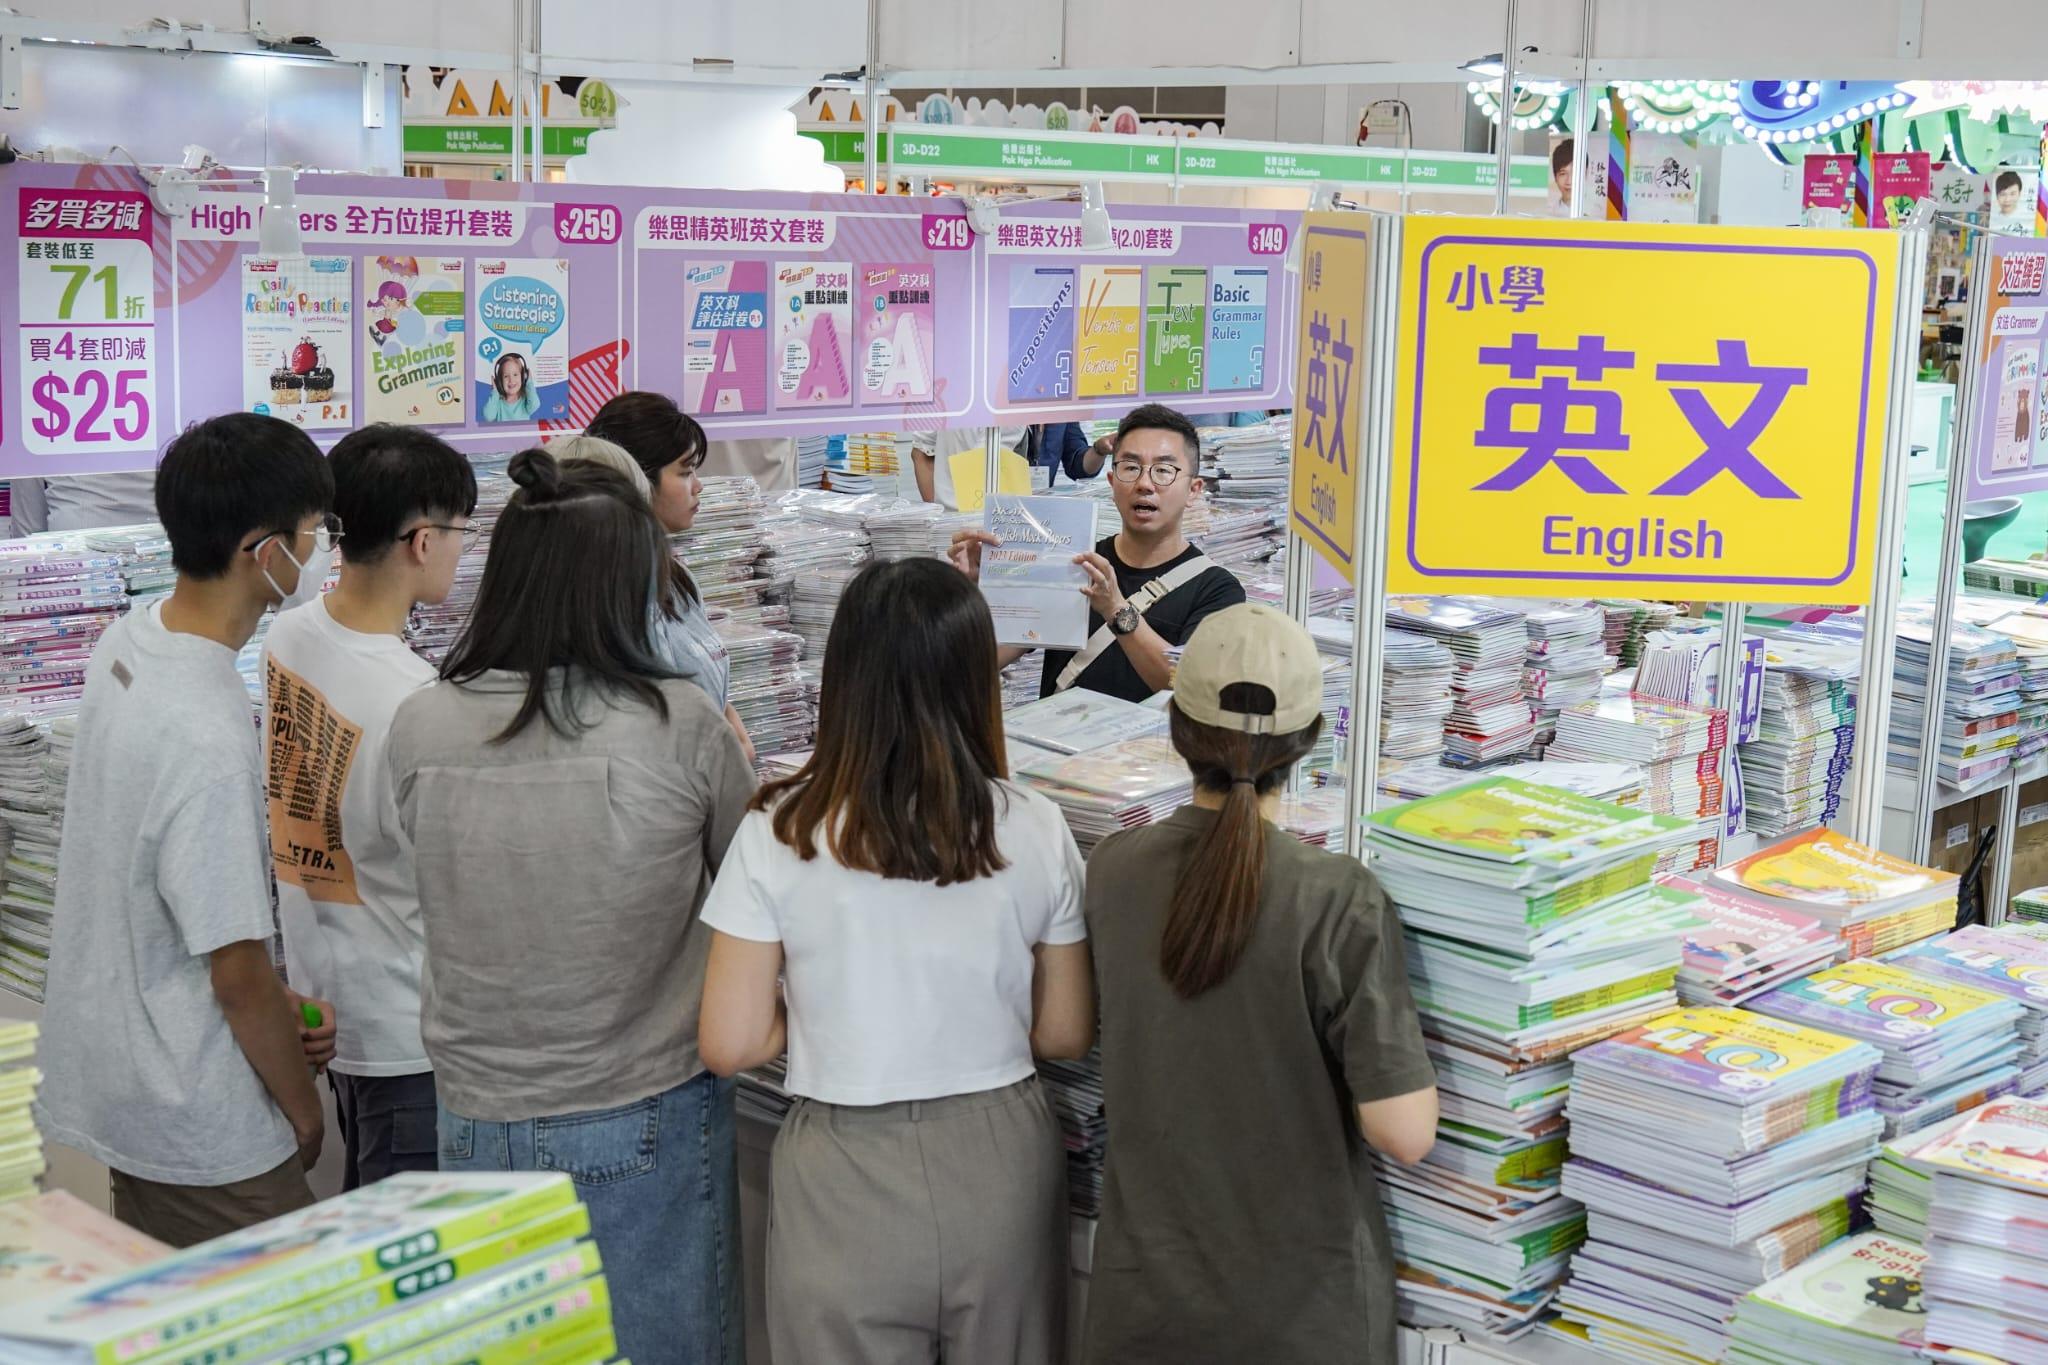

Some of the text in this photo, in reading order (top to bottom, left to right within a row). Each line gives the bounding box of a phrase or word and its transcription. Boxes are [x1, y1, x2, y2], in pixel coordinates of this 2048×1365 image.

[581, 92, 607, 113] 50%
[572, 136, 586, 147] HK
[902, 143, 940, 156] 3D-D22
[1034, 156, 1072, 167] Publication
[1146, 154, 1160, 166] HK
[1184, 156, 1217, 169] 3D-D22
[1380, 165, 1391, 176] HK
[25, 197, 145, 231] 多買多減
[191, 204, 251, 235] High
[345, 205, 513, 237] 全方位提升套裝
[559, 207, 616, 241] $259
[648, 213, 825, 244] 樂思精英班英文套裝
[928, 218, 968, 248] $219
[1252, 228, 1283, 252] $149
[26, 242, 95, 260] 套裝低至
[261, 276, 296, 299] Daily
[815, 273, 848, 288] 英文科
[898, 273, 930, 288] 英文科
[1446, 264, 1545, 313] 小學
[493, 285, 557, 309] Listening
[700, 295, 740, 311] 英文科
[804, 290, 848, 305] 重點訓練
[888, 290, 930, 304] 重點訓練
[1213, 283, 1250, 303] Basic
[246, 293, 350, 319] Reading Practice
[484, 302, 556, 323] Strategies
[1157, 282, 1195, 333] Text
[1212, 308, 1262, 322] Grammar
[696, 311, 749, 328] 評估試卷
[1995, 315, 2009, 331] 文法
[1010, 280, 1072, 387] Prepositions
[1147, 313, 1192, 367] Types
[1212, 326, 1241, 340] Rules
[30, 332, 146, 362] 買4套即減
[372, 340, 456, 373] Exploring
[481, 340, 498, 356] P.1
[378, 359, 455, 394] Grammar
[1303, 309, 1354, 477] 英文
[32, 370, 150, 443] $25
[322, 404, 348, 420] P.1
[1468, 332, 1809, 500] 英文
[1310, 472, 1337, 528] English
[1542, 515, 1724, 567] English
[1868, 1239, 1928, 1262] Read
